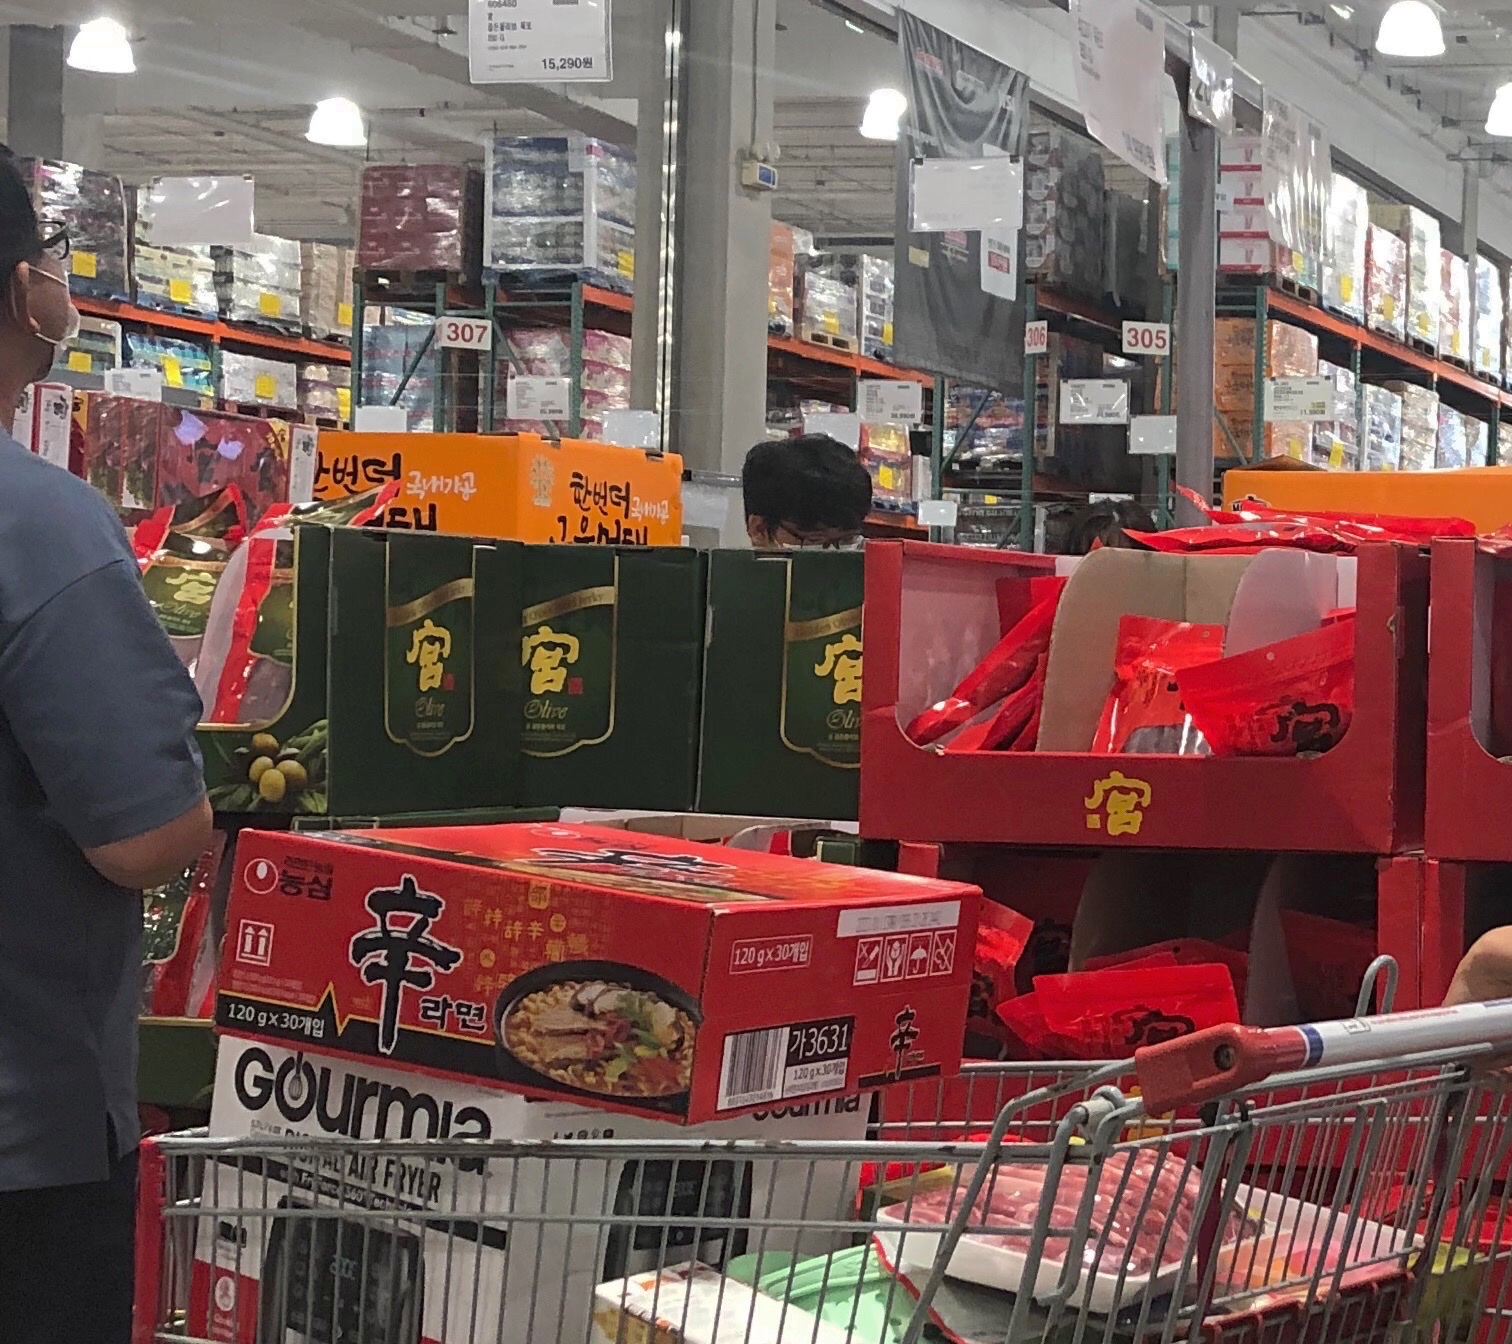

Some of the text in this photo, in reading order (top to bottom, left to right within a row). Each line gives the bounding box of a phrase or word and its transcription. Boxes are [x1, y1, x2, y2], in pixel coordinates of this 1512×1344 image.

[541, 57, 593, 70] 15,290원
[447, 323, 488, 343] 307
[1026, 325, 1046, 347] 306
[1126, 327, 1157, 349] 305
[405, 469, 478, 502] 국내가공
[569, 471, 631, 520] 한번더
[523, 698, 569, 720] Olive
[278, 868, 333, 901] 농심
[349, 872, 488, 1055] 辛 라면
[733, 945, 755, 966] 120
[227, 1002, 256, 1023] 120
[789, 1022, 850, 1060] 가3631
